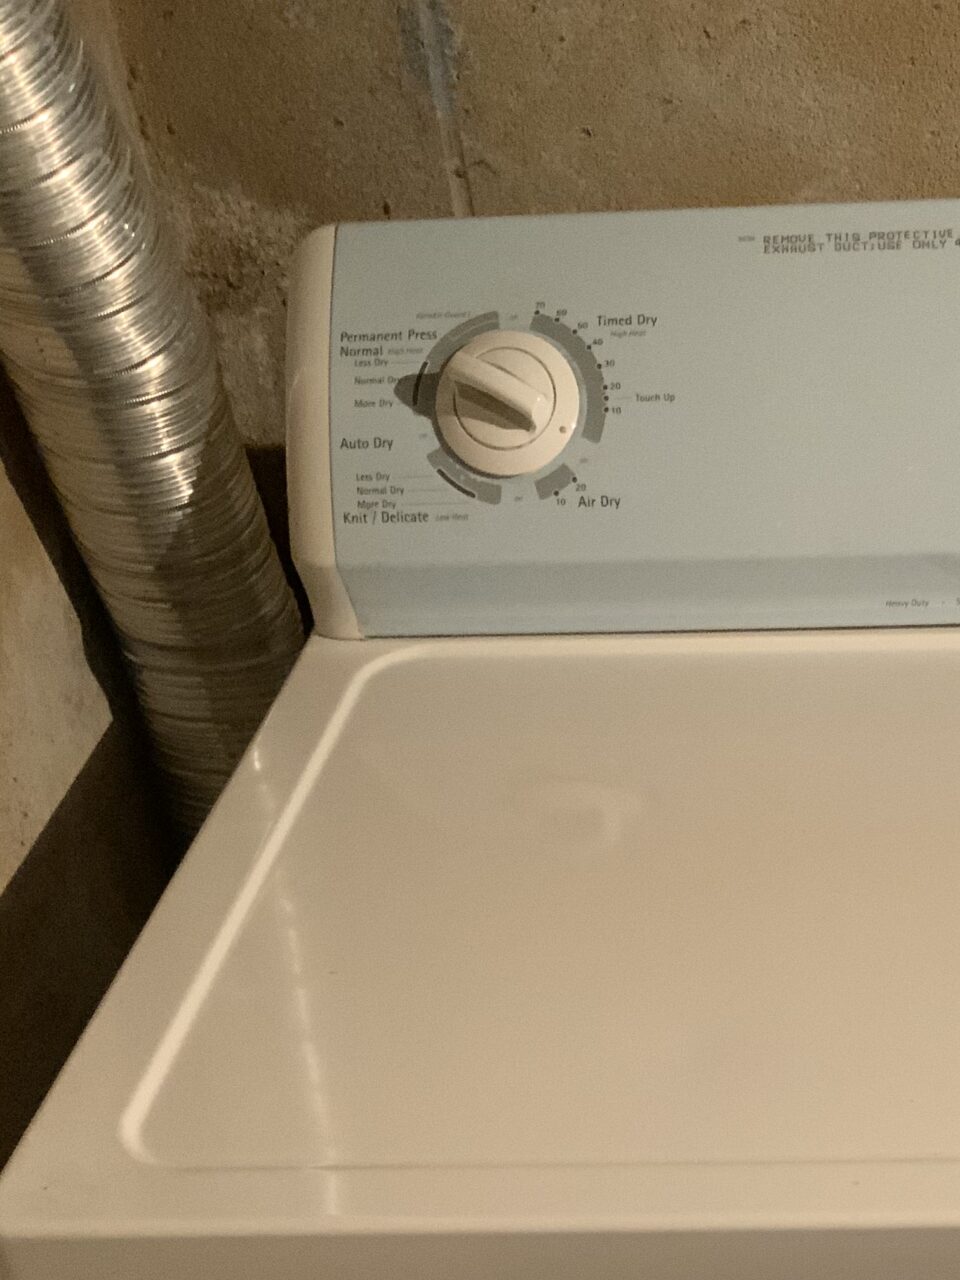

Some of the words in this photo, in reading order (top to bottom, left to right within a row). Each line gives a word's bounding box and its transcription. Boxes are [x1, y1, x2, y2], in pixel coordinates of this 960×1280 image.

[762, 234, 815, 244] REMOVE
[826, 232, 861, 242] THIS
[868, 228, 953, 241] PROTECTIVE
[763, 243, 825, 254] EXHAUST
[912, 239, 947, 249] ONLY
[597, 315, 632, 326] Timed
[637, 314, 658, 326] Dry
[340, 331, 402, 342] Permanent
[408, 329, 437, 340] Press
[340, 346, 383, 356] Normal
[374, 359, 388, 367] Dry
[610, 382, 621, 390] 20
[664, 393, 675, 402] Up
[379, 399, 393, 407] Dry
[340, 438, 369, 449] Auto
[373, 437, 393, 450] Dry
[375, 472, 390, 481] Dry
[356, 487, 387, 495] Normal
[389, 486, 404, 495] Dry
[382, 500, 396, 509] Dry
[556, 498, 566, 506] 10
[578, 496, 596, 507] Air
[600, 496, 620, 509] Dry
[343, 512, 367, 524] Knit
[381, 511, 429, 523] Delicate
